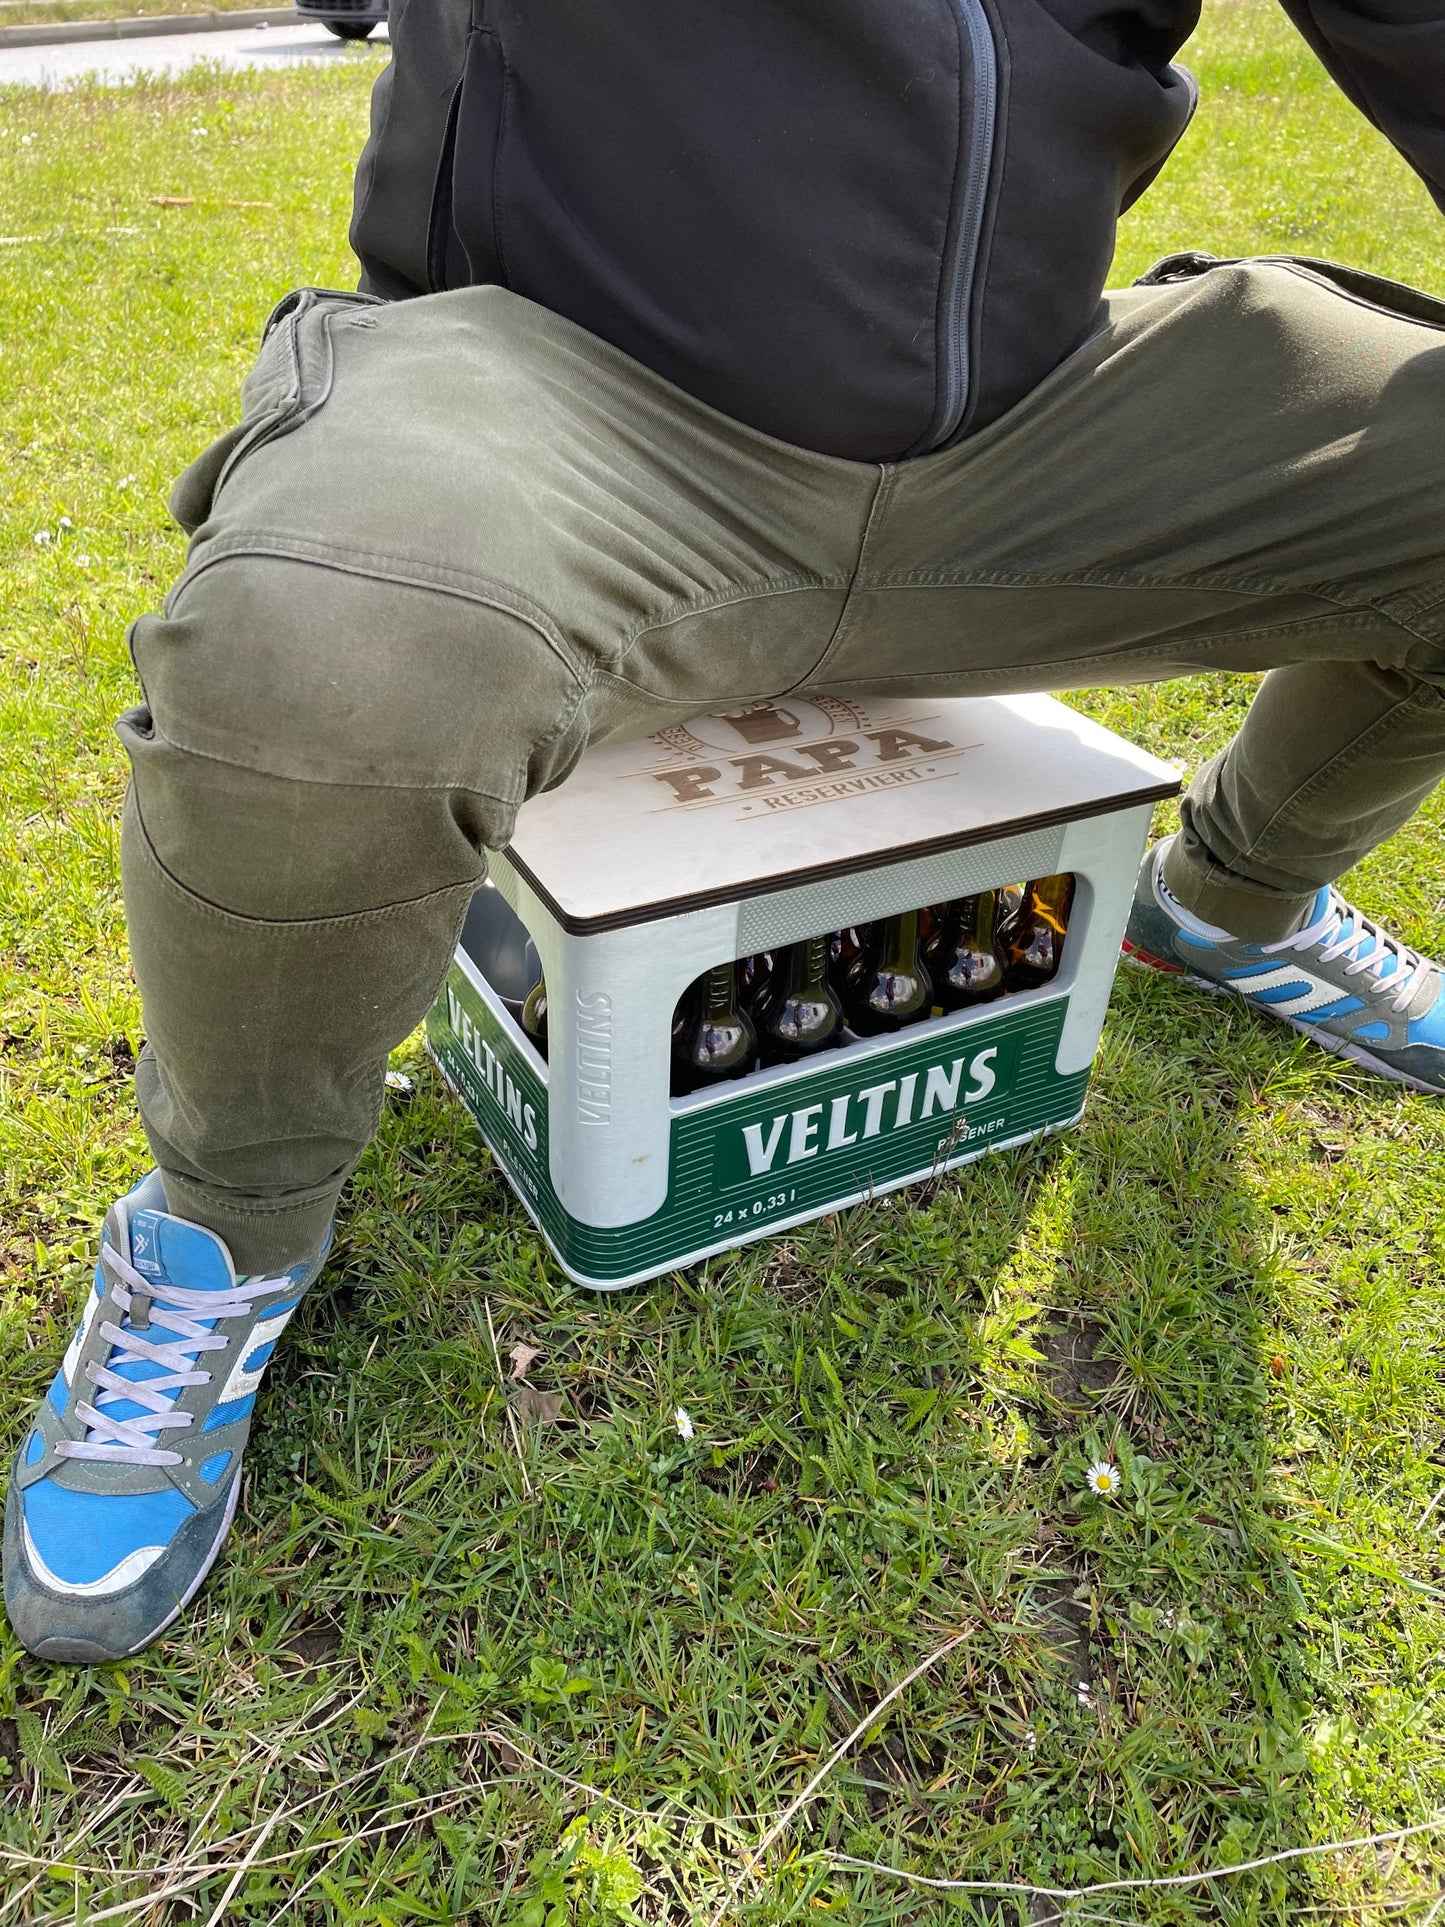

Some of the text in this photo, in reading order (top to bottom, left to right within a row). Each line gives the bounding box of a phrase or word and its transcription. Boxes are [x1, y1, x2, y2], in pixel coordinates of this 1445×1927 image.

[651, 728, 955, 803] PAPA
[762, 767, 923, 809] RESERVIERT
[448, 986, 538, 1151] VELTINS
[576, 988, 613, 1127] VELTINS
[742, 1046, 998, 1177] VELTINS
[713, 1210, 734, 1228] 24
[738, 1208, 748, 1220] x
[752, 1193, 787, 1214] 0,33
